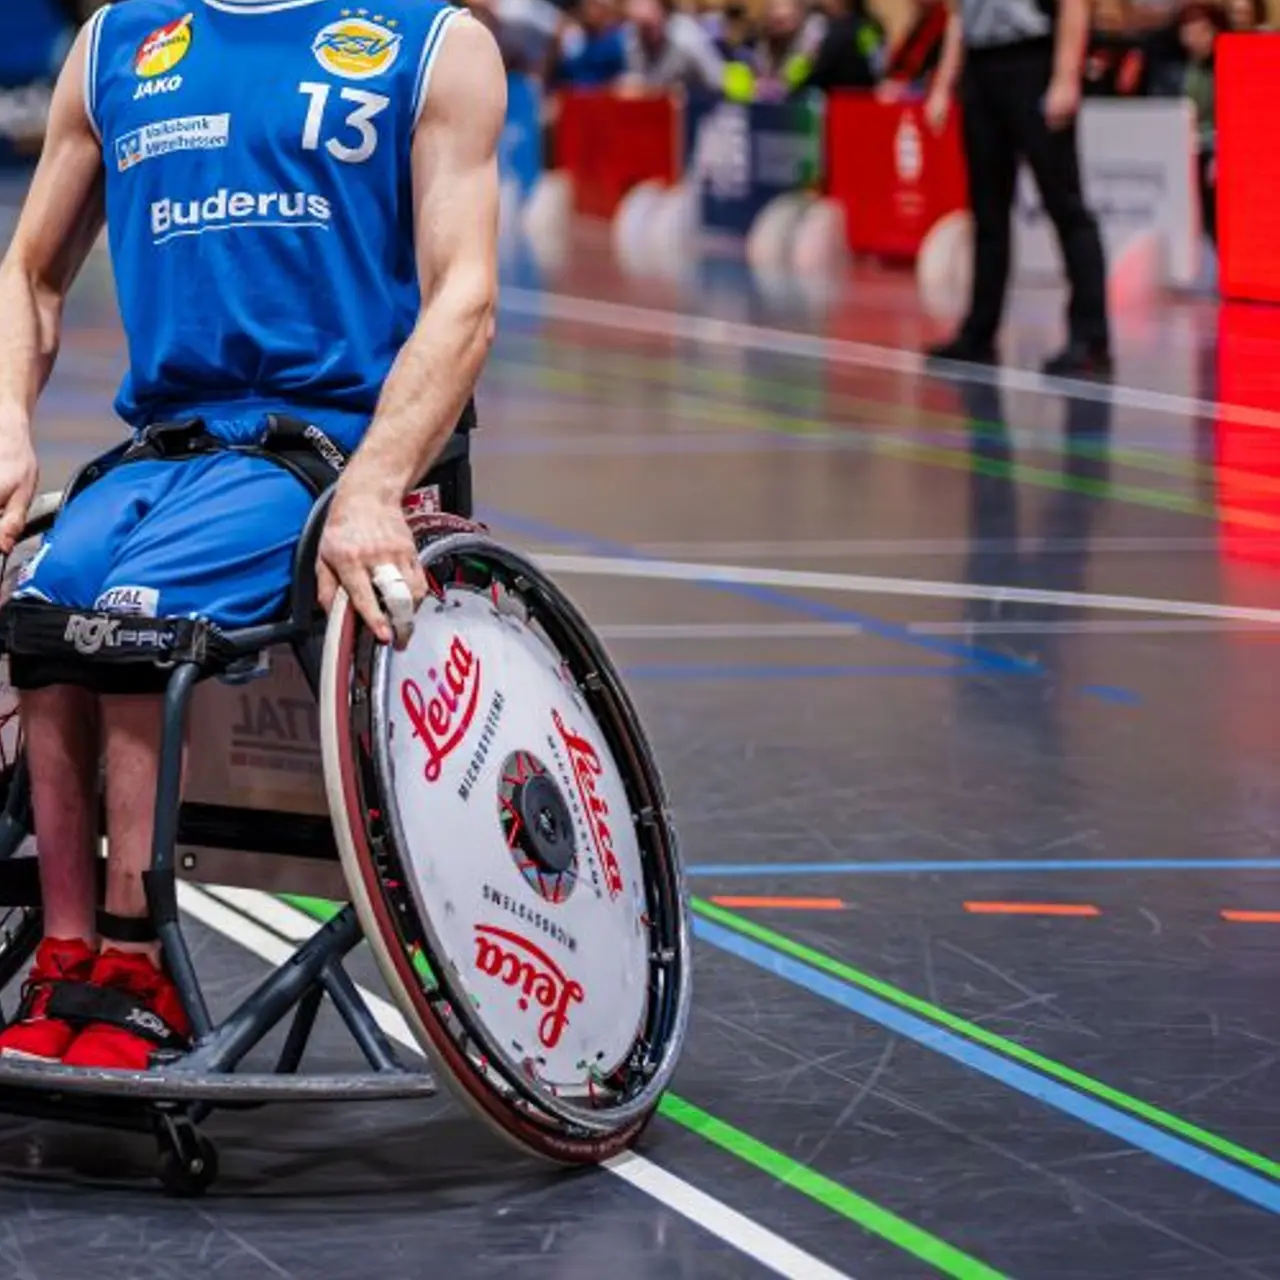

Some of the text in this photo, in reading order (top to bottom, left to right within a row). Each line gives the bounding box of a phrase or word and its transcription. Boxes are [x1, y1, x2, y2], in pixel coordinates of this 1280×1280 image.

[132, 74, 183, 101] JAKO
[298, 81, 390, 163] 13
[151, 188, 332, 234] Buderus
[401, 635, 481, 783] Leica
[458, 690, 506, 802] MICROSYSTEMS
[551, 707, 623, 904] Leica
[474, 924, 585, 1049] Leica
